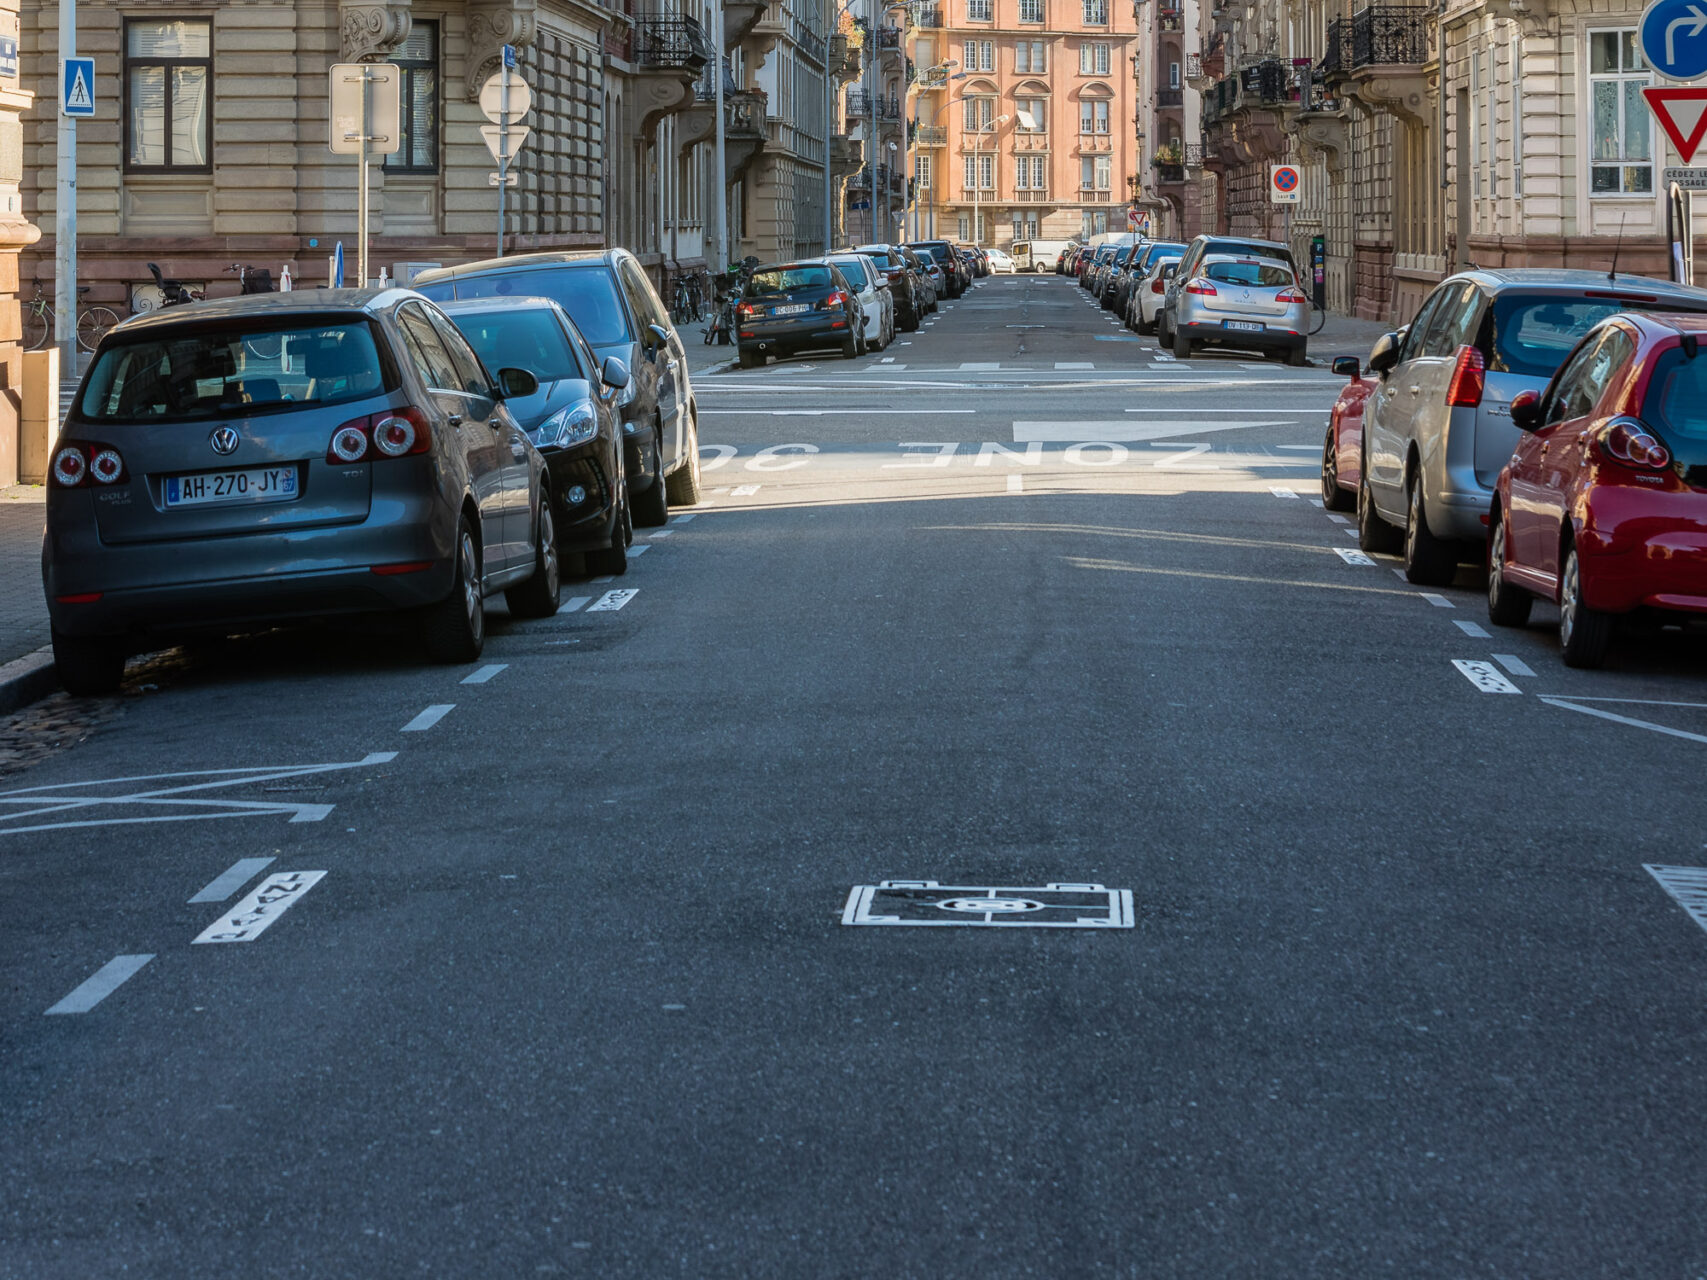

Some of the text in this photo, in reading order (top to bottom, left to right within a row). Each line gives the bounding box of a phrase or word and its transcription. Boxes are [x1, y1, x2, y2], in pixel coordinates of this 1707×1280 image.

[1666, 169, 1694, 178] CÉDEZ
[881, 440, 1221, 470] ZONE
[182, 470, 280, 499] AH-270-JY
[1635, 476, 1664, 484] TOYOTA
